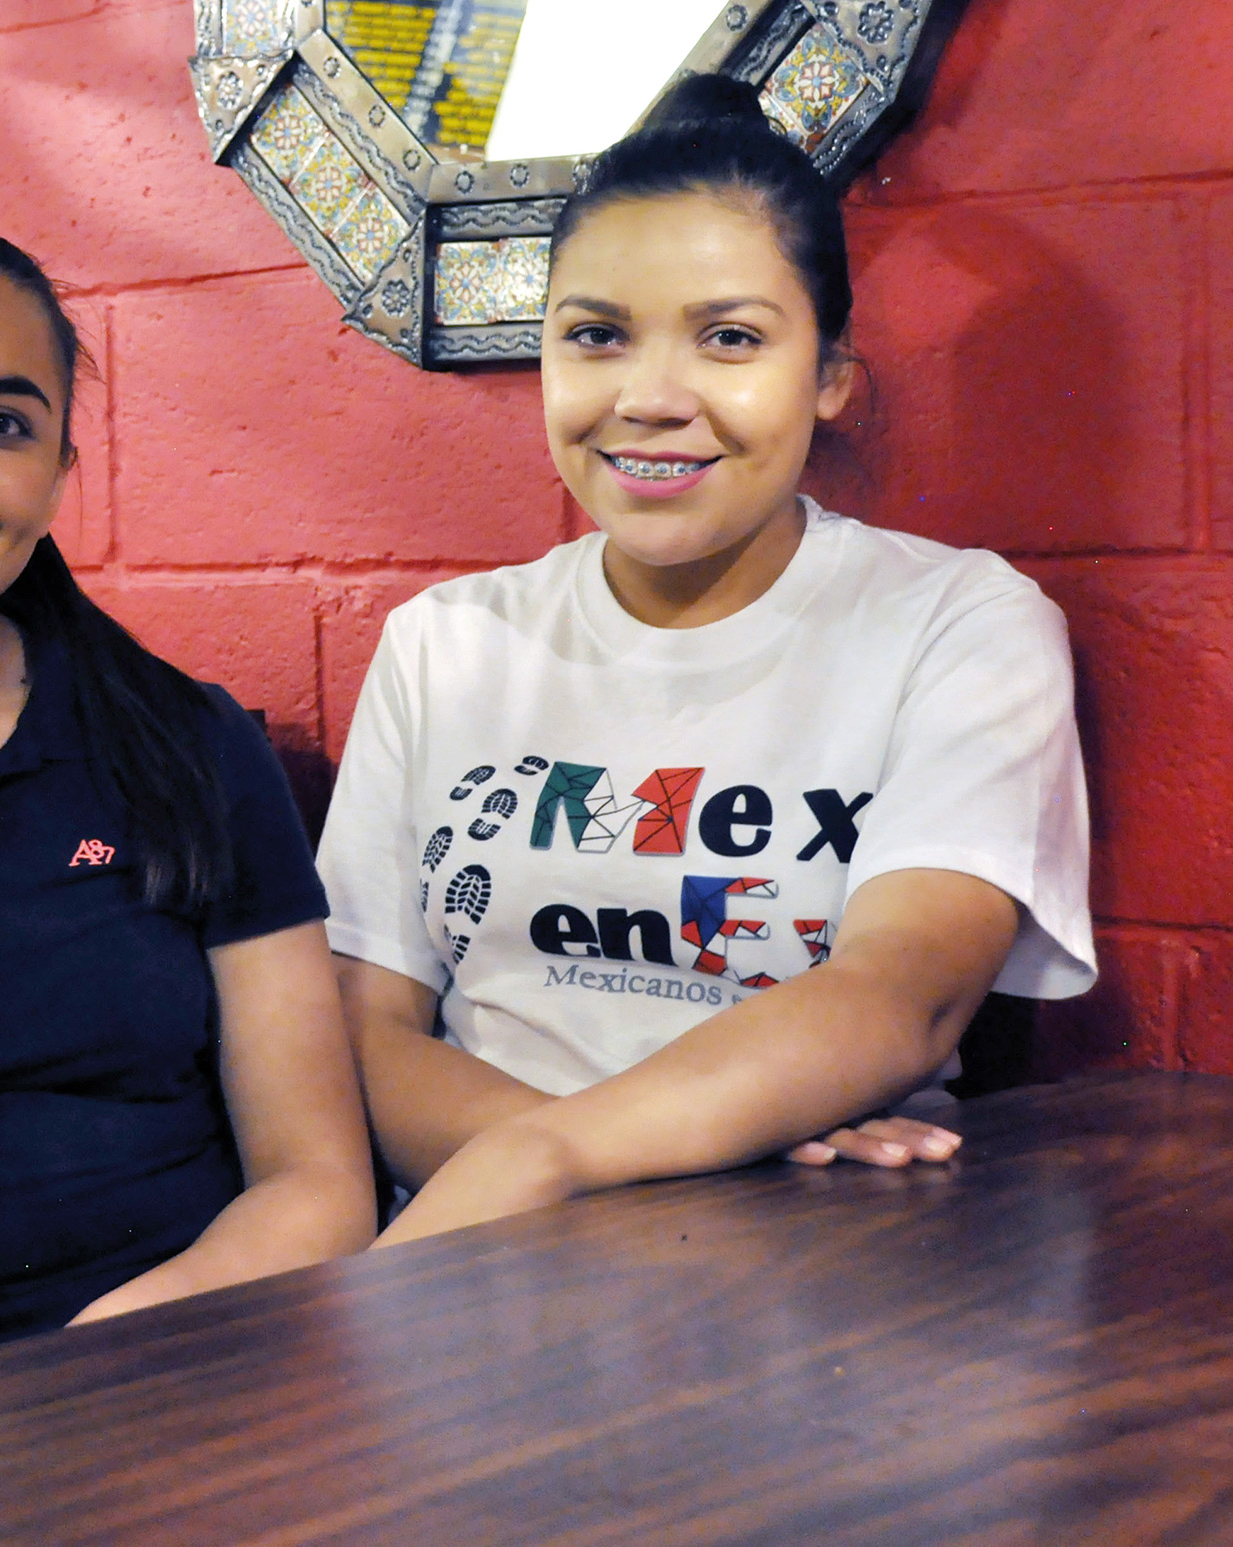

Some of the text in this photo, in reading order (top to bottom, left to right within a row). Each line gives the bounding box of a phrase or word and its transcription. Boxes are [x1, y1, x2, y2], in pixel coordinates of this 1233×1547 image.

[529, 761, 873, 863] Mex
[68, 839, 115, 867] A87
[543, 964, 723, 1006] Mexicanos
